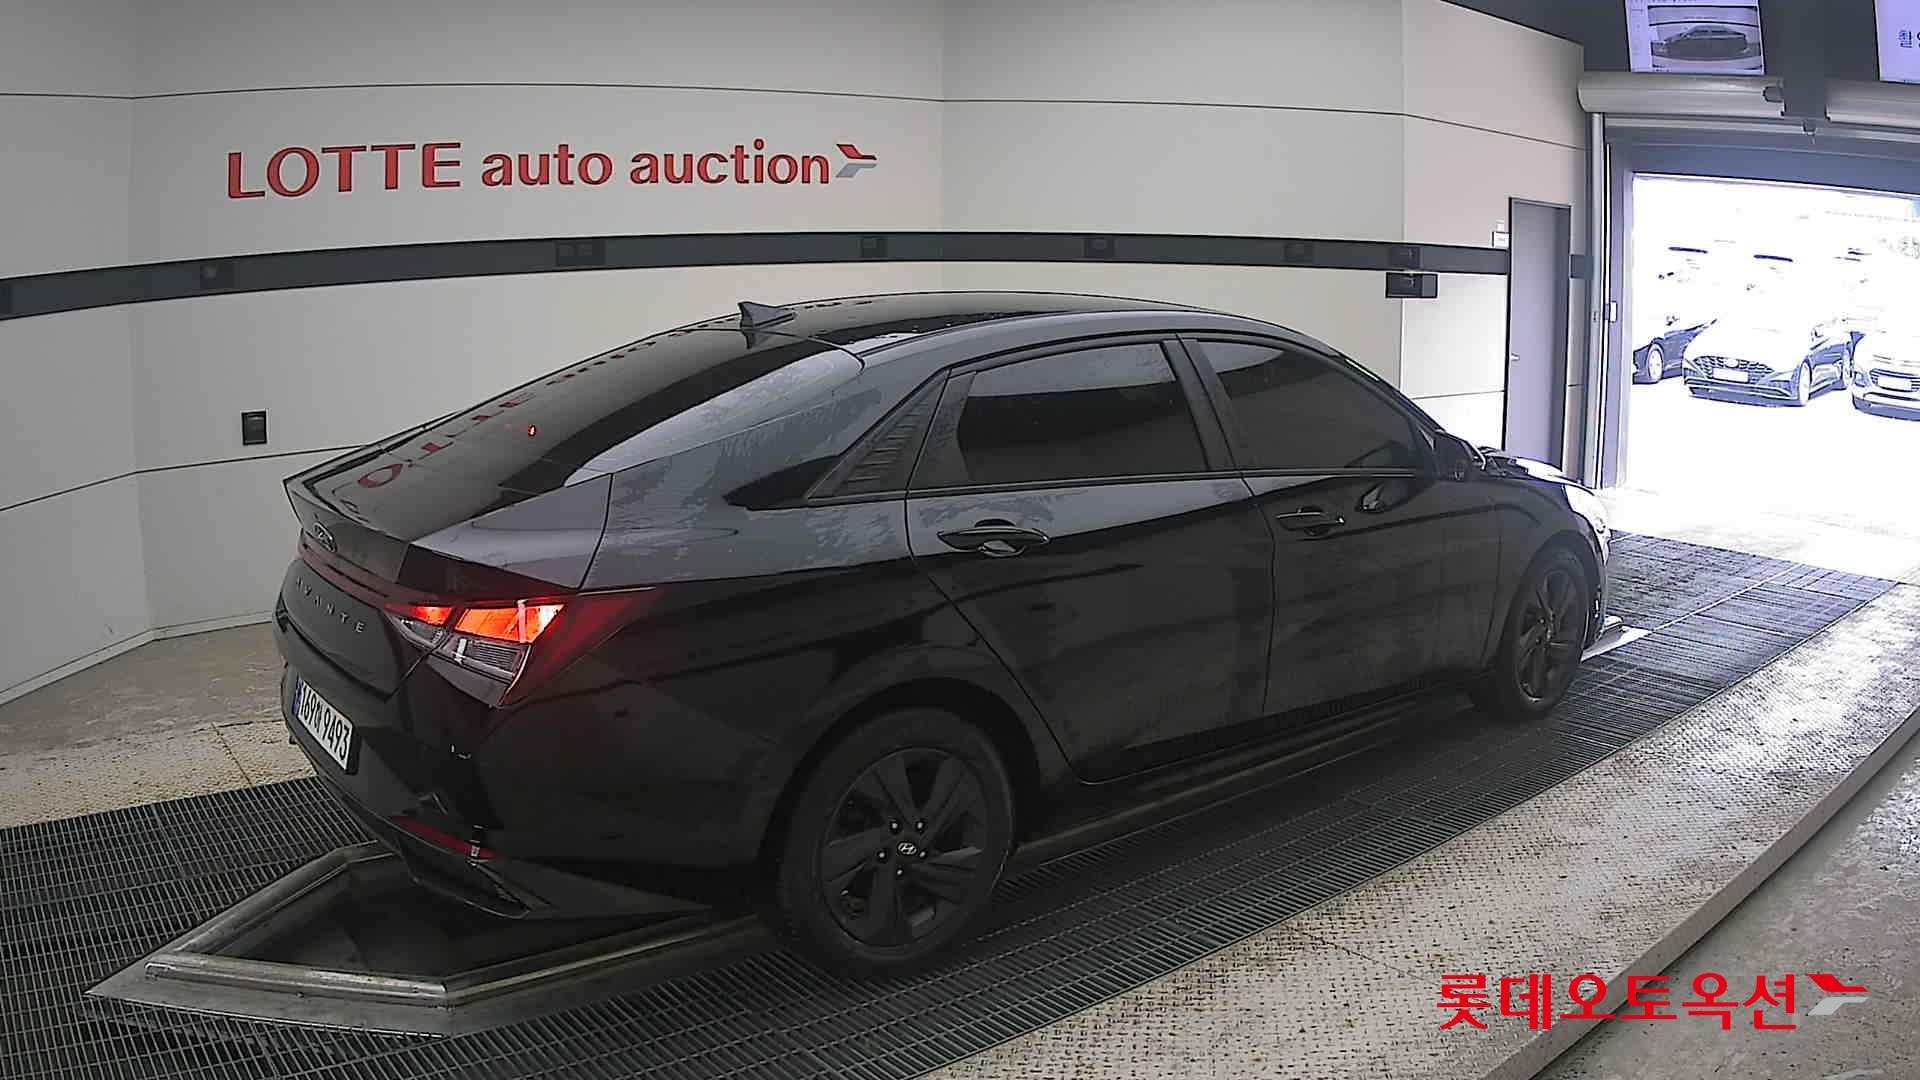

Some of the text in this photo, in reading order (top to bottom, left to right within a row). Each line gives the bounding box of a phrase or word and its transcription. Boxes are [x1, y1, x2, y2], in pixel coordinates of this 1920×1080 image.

[227, 138, 830, 199] LOTTE auto auction
